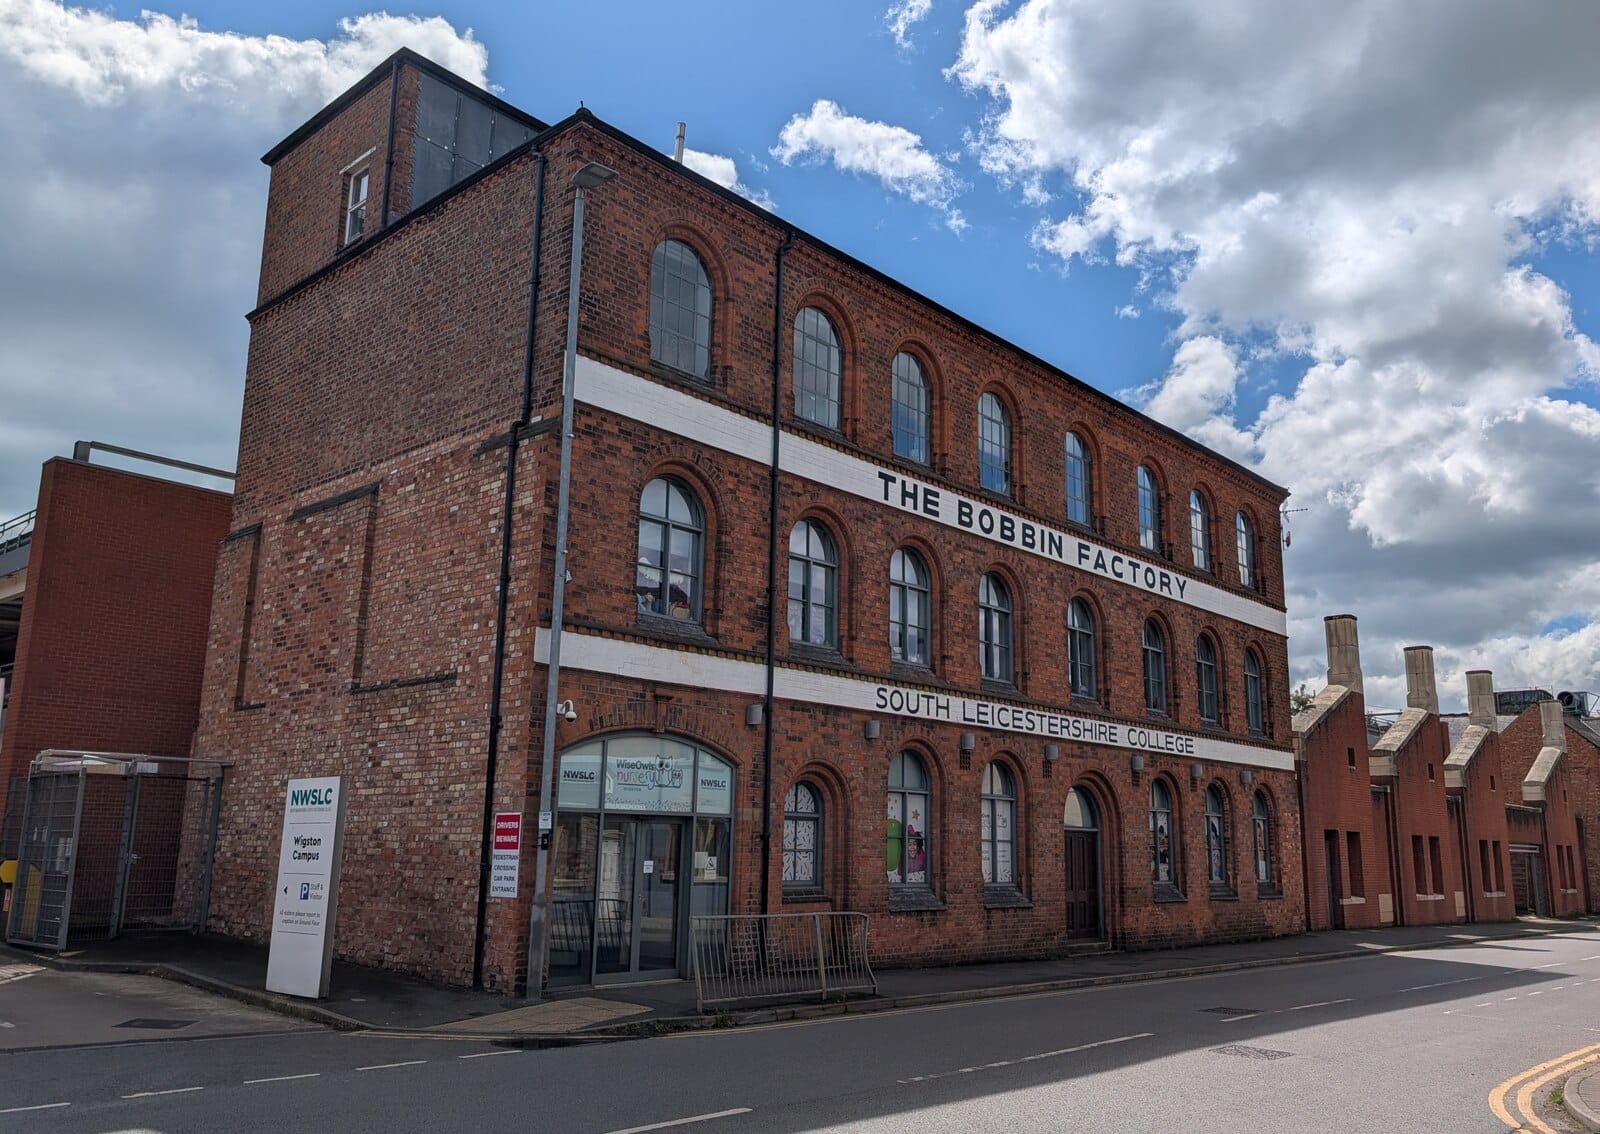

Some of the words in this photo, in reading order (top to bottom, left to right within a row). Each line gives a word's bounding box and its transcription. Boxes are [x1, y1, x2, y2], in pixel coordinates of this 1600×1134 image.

[878, 471, 940, 518] THE
[958, 499, 1063, 559] BOBBIN
[1077, 542, 1187, 599] FACTORY
[876, 687, 950, 719] SOUTH
[962, 700, 1118, 743] LEICESTERSHIRE
[1127, 727, 1194, 754] COLLEGE
[563, 770, 595, 780] NWSLC
[701, 779, 727, 788] NWSLC
[291, 788, 333, 806] NWSLC
[497, 821, 519, 829] DRIVERS
[293, 835, 322, 849] Wigston
[496, 835, 518, 843] BEWARE
[292, 850, 320, 863] Campus
